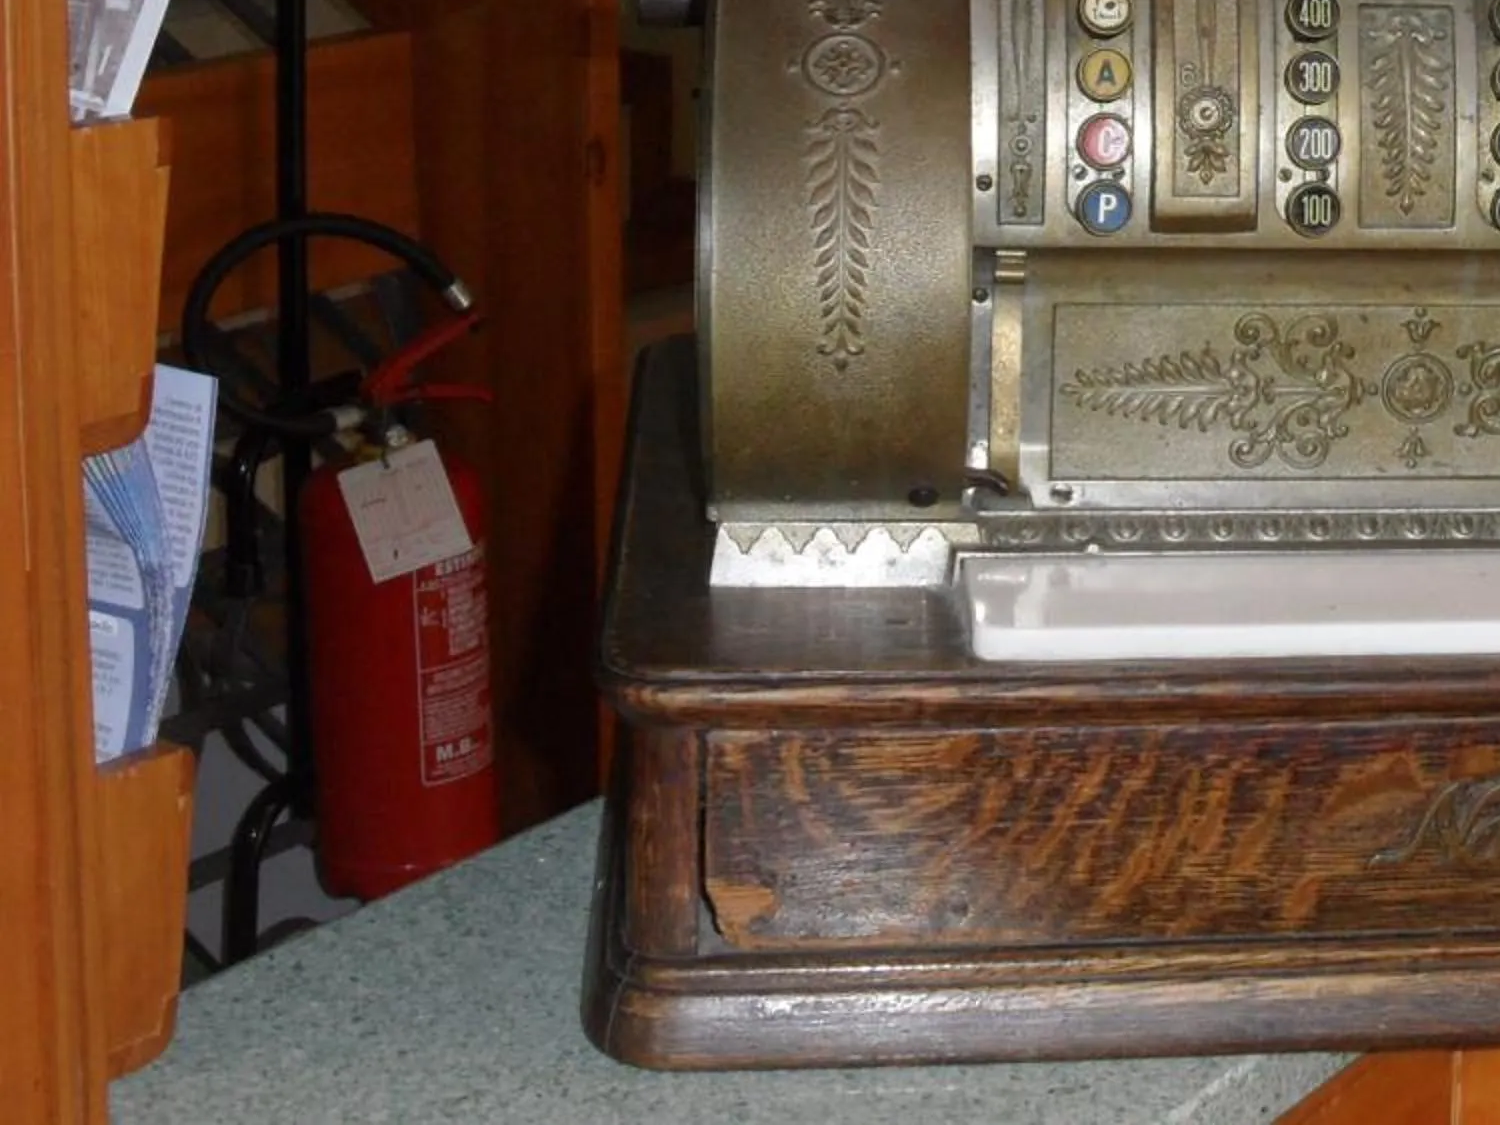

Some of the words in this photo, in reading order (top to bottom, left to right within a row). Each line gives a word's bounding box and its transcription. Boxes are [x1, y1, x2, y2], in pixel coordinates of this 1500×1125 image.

[1095, 59, 1115, 87] A
[1299, 61, 1331, 92] 300
[1096, 126, 1115, 157] C
[1299, 127, 1332, 160] 200
[1098, 193, 1116, 224] P
[1301, 193, 1331, 225] 100
